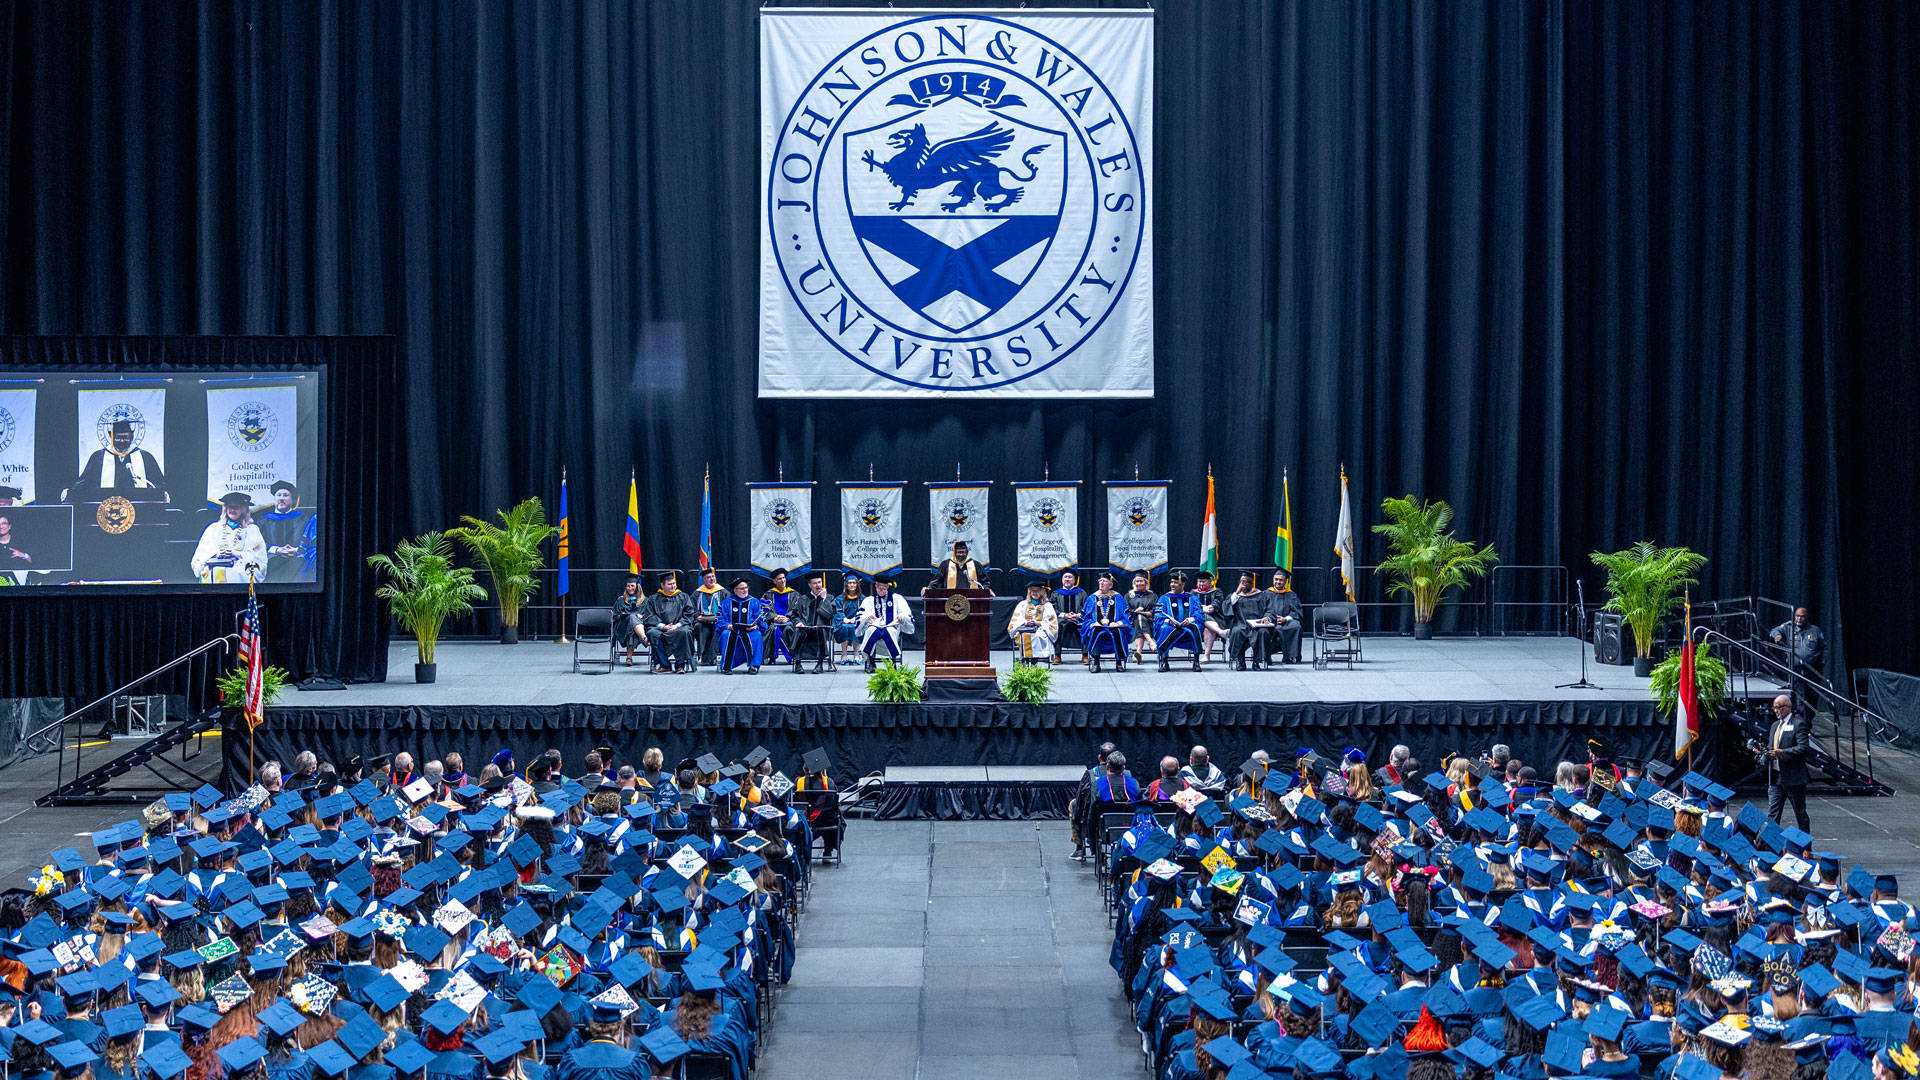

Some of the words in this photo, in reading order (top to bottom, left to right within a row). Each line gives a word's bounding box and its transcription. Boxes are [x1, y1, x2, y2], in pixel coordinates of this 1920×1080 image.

[921, 74, 992, 96] 1914
[777, 25, 967, 213] JOHNSON
[986, 30, 1018, 65] &
[1034, 46, 1134, 215] WALES
[798, 258, 1116, 379] UNIVERSITY
[2, 464, 29, 473] White
[231, 462, 264, 471] College
[265, 460, 276, 469] of
[1, 474, 12, 483] of
[229, 471, 277, 482] Hospitality
[225, 483, 271, 492] Manageme
[766, 538, 789, 546] College
[1033, 538, 1055, 546] College
[1123, 537, 1146, 545] College
[857, 545, 878, 553] College
[1032, 545, 1064, 553] Hospitality
[1781, 951, 1790, 964] A
[1773, 973, 1789, 985] GO
